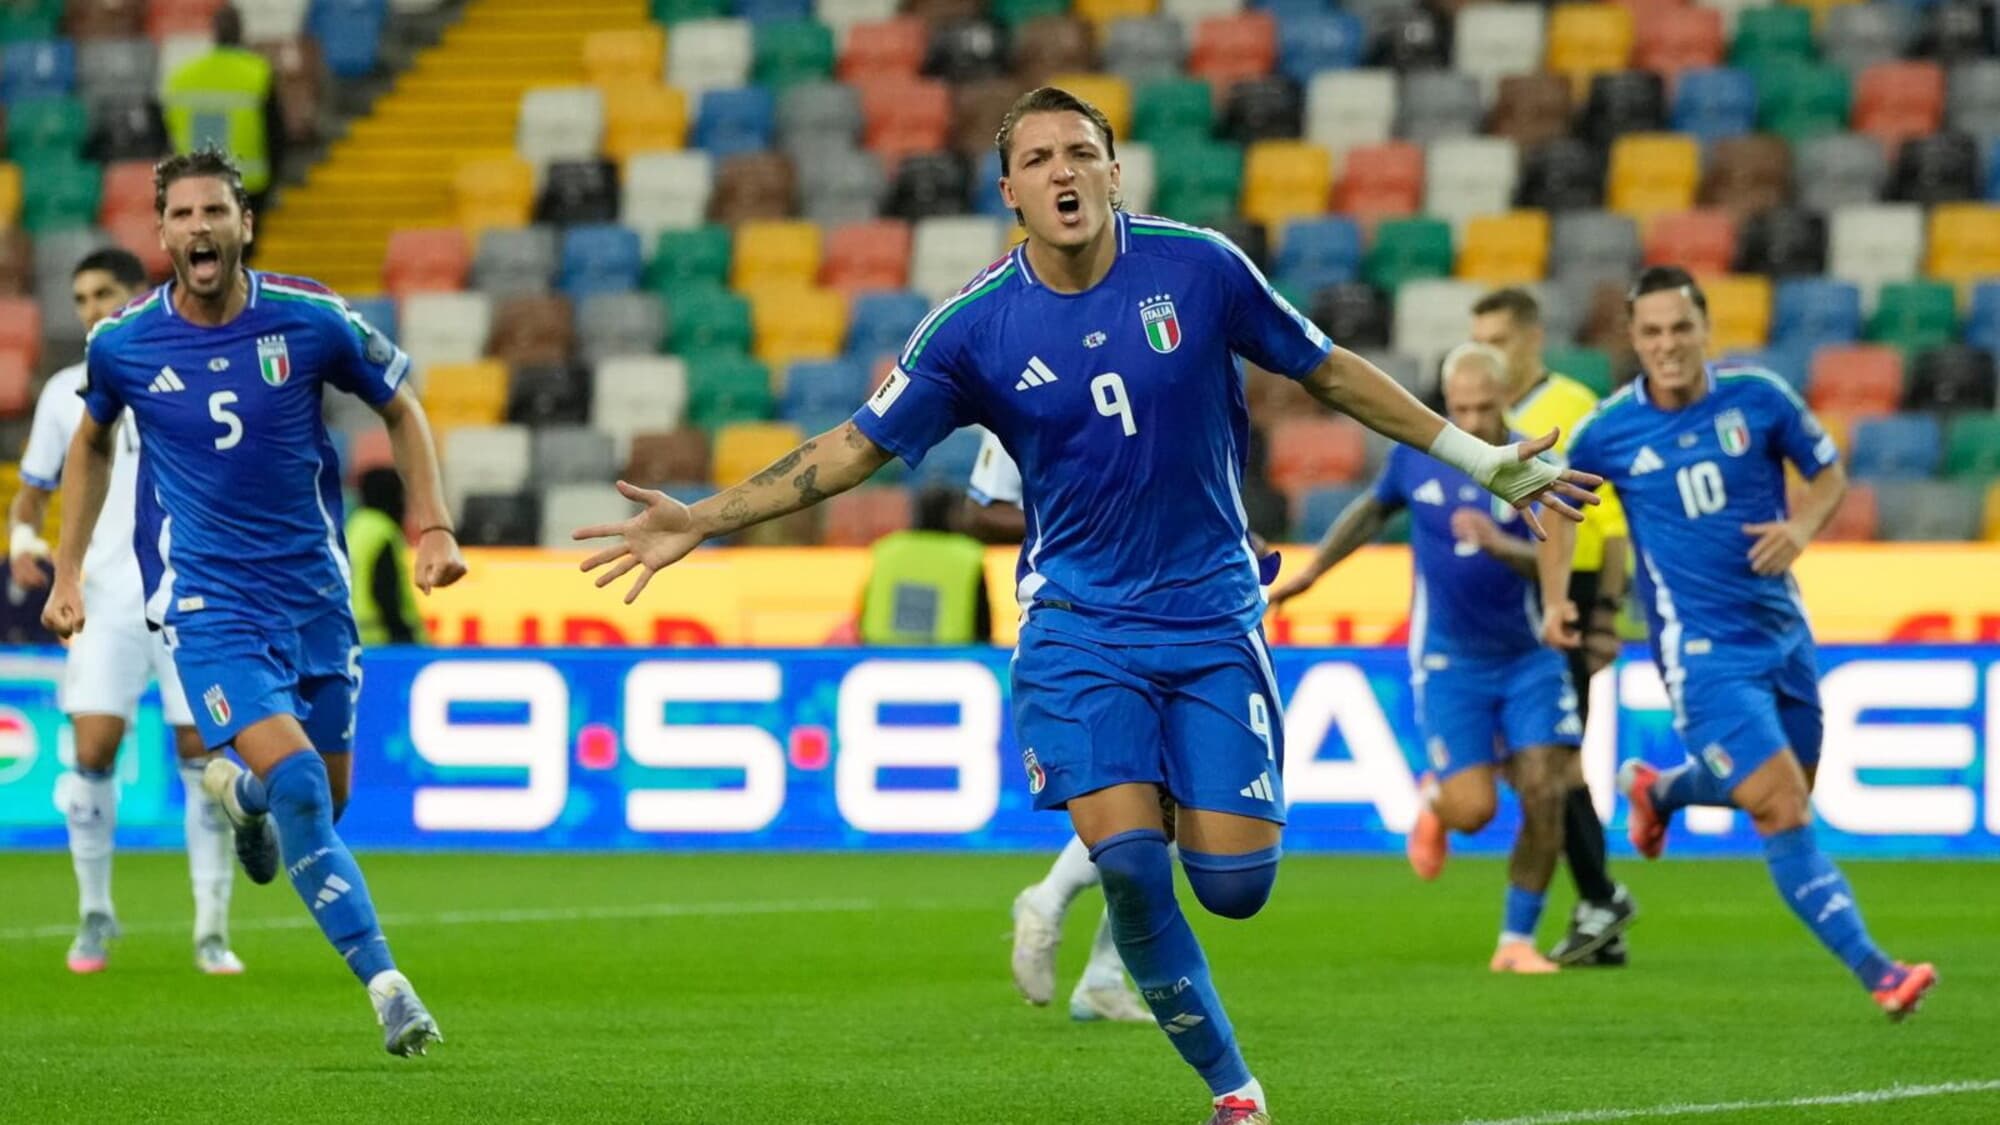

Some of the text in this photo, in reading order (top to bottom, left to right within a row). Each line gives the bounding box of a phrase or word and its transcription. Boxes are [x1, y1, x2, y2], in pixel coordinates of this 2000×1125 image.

[208, 390, 243, 450] 5
[1090, 372, 1137, 437] 9
[1676, 461, 1727, 519] 10
[1249, 693, 1274, 761] 9
